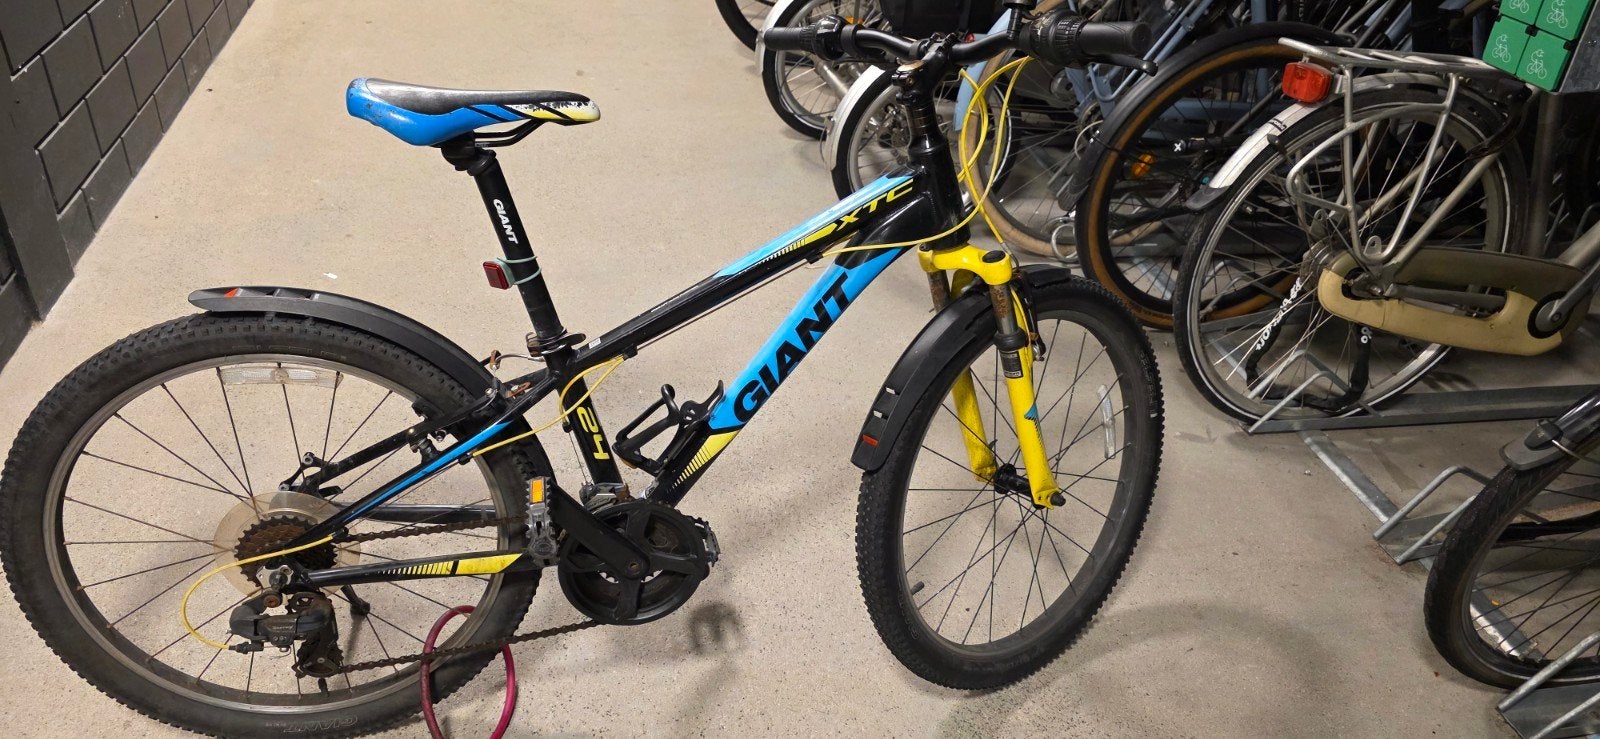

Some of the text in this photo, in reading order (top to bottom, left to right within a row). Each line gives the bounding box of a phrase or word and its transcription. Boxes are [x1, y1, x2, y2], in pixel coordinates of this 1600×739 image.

[493, 199, 519, 244] GIANT
[836, 178, 914, 231] XTC
[733, 271, 850, 423] GIANT
[576, 406, 610, 460] 24
